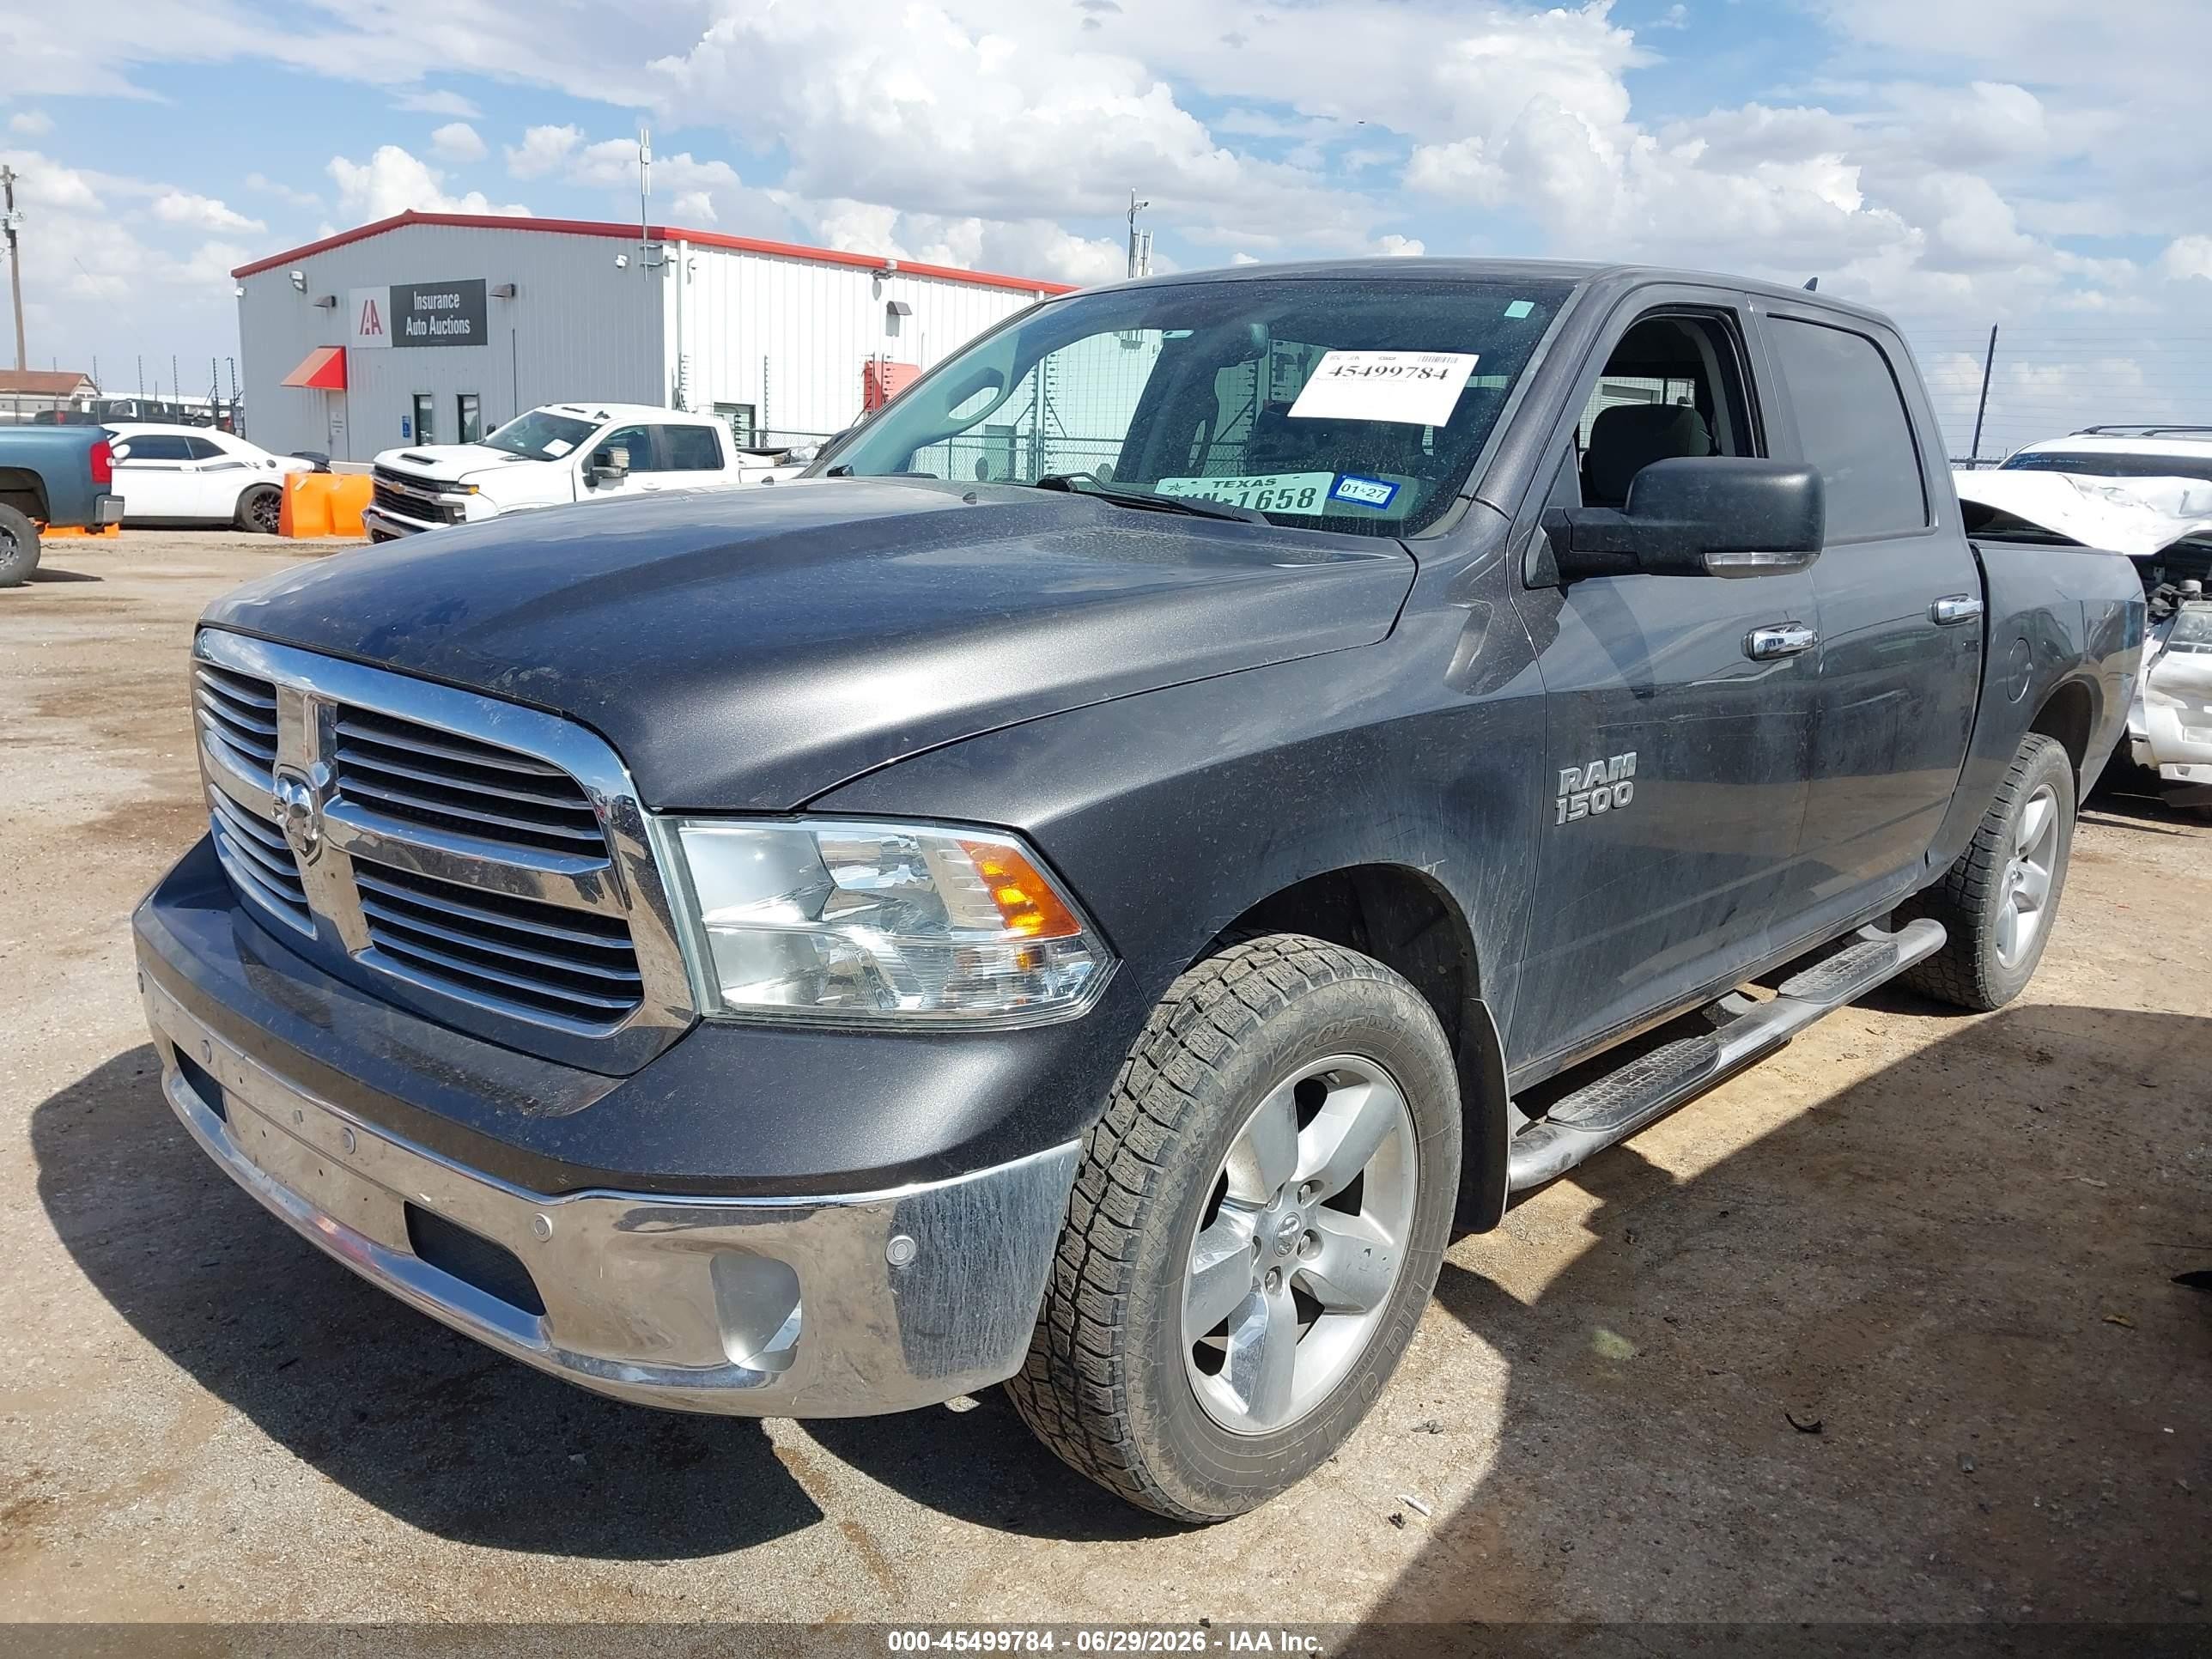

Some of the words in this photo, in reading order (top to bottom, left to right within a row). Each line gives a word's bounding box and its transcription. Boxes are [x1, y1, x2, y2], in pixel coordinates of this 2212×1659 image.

[414, 290, 460, 311] Insurance
[405, 315, 428, 336] Auto
[429, 314, 471, 335] Auctions
[1328, 365, 1449, 380] 45499784
[1212, 477, 1278, 489] TEXAS
[1557, 751, 1637, 797] RAM
[1555, 781, 1634, 825] 1500
